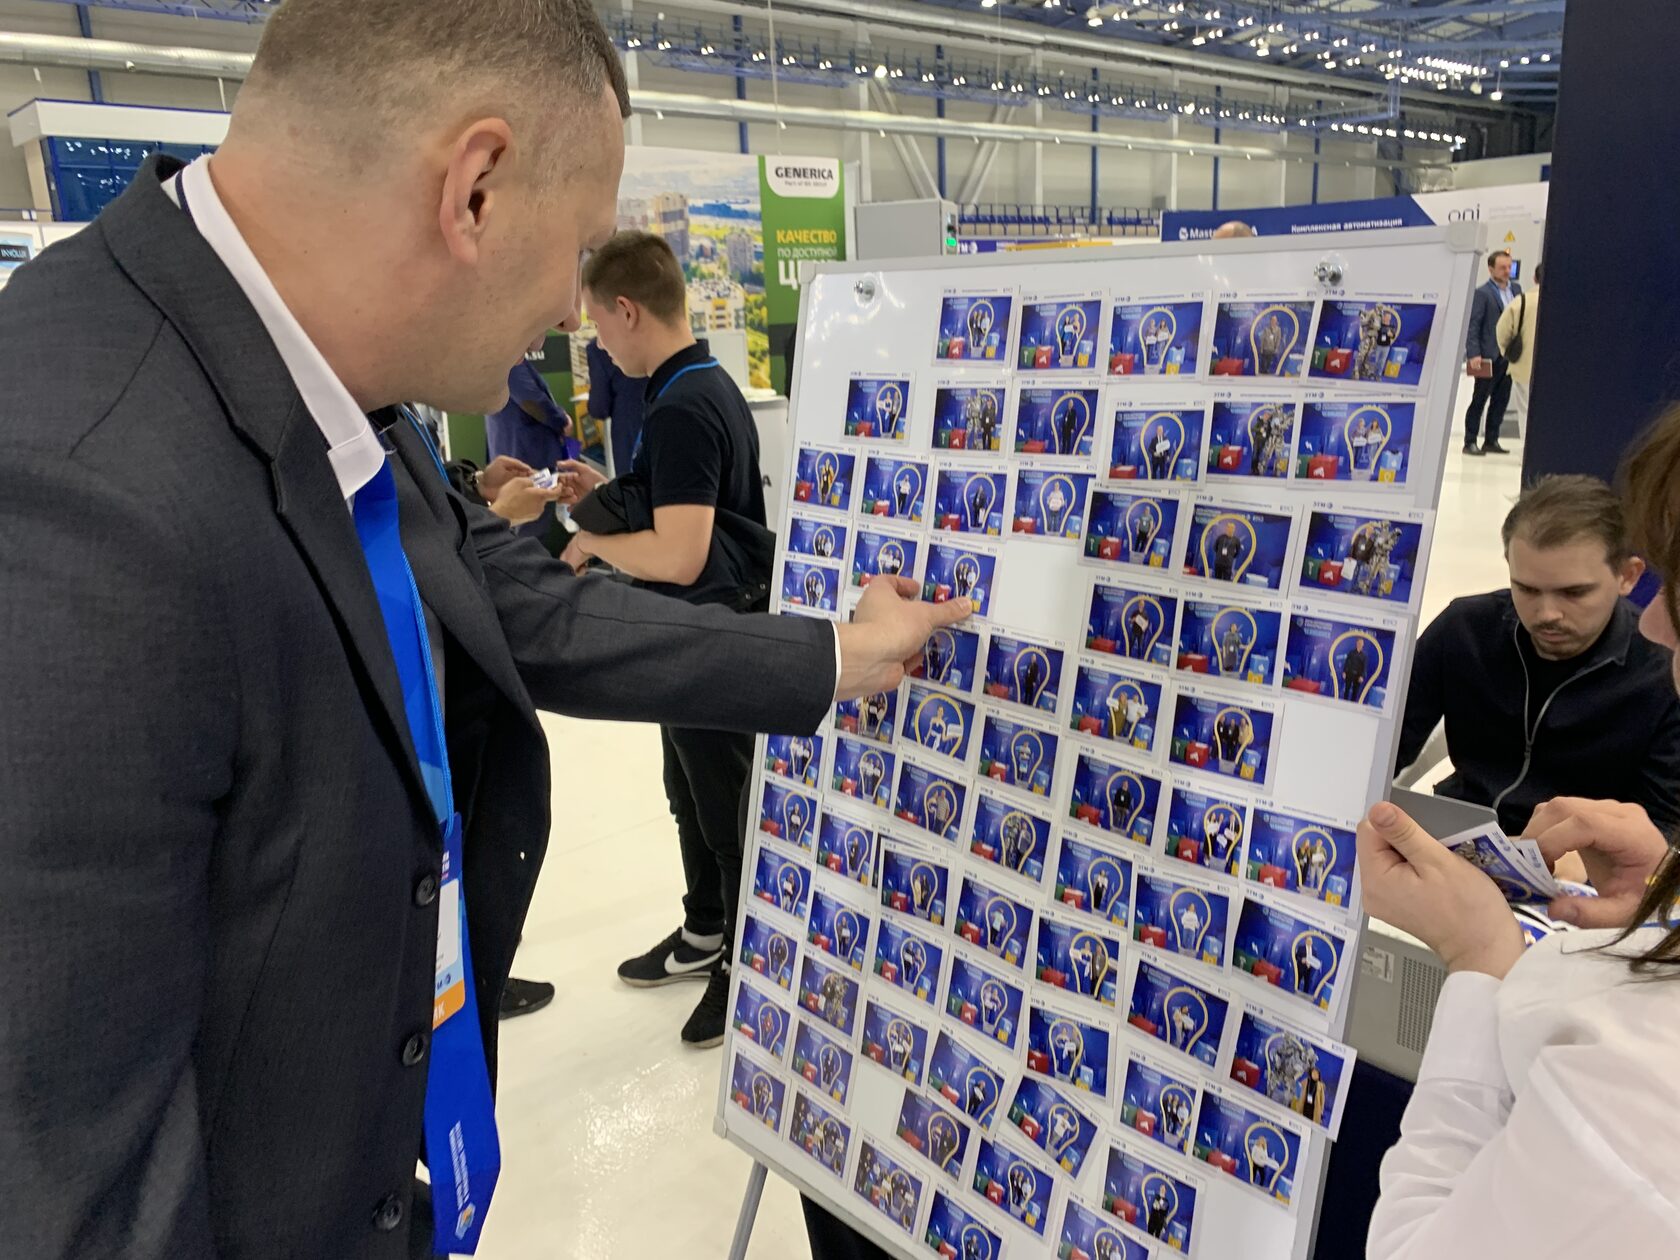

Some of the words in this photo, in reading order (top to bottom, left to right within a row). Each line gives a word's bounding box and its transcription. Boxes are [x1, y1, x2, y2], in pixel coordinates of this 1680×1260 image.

[775, 166, 834, 180] GENERICA
[1291, 222, 1343, 234] Комплексная
[1343, 218, 1404, 231] автоматизация
[776, 229, 837, 244] КАЧЕСТВО
